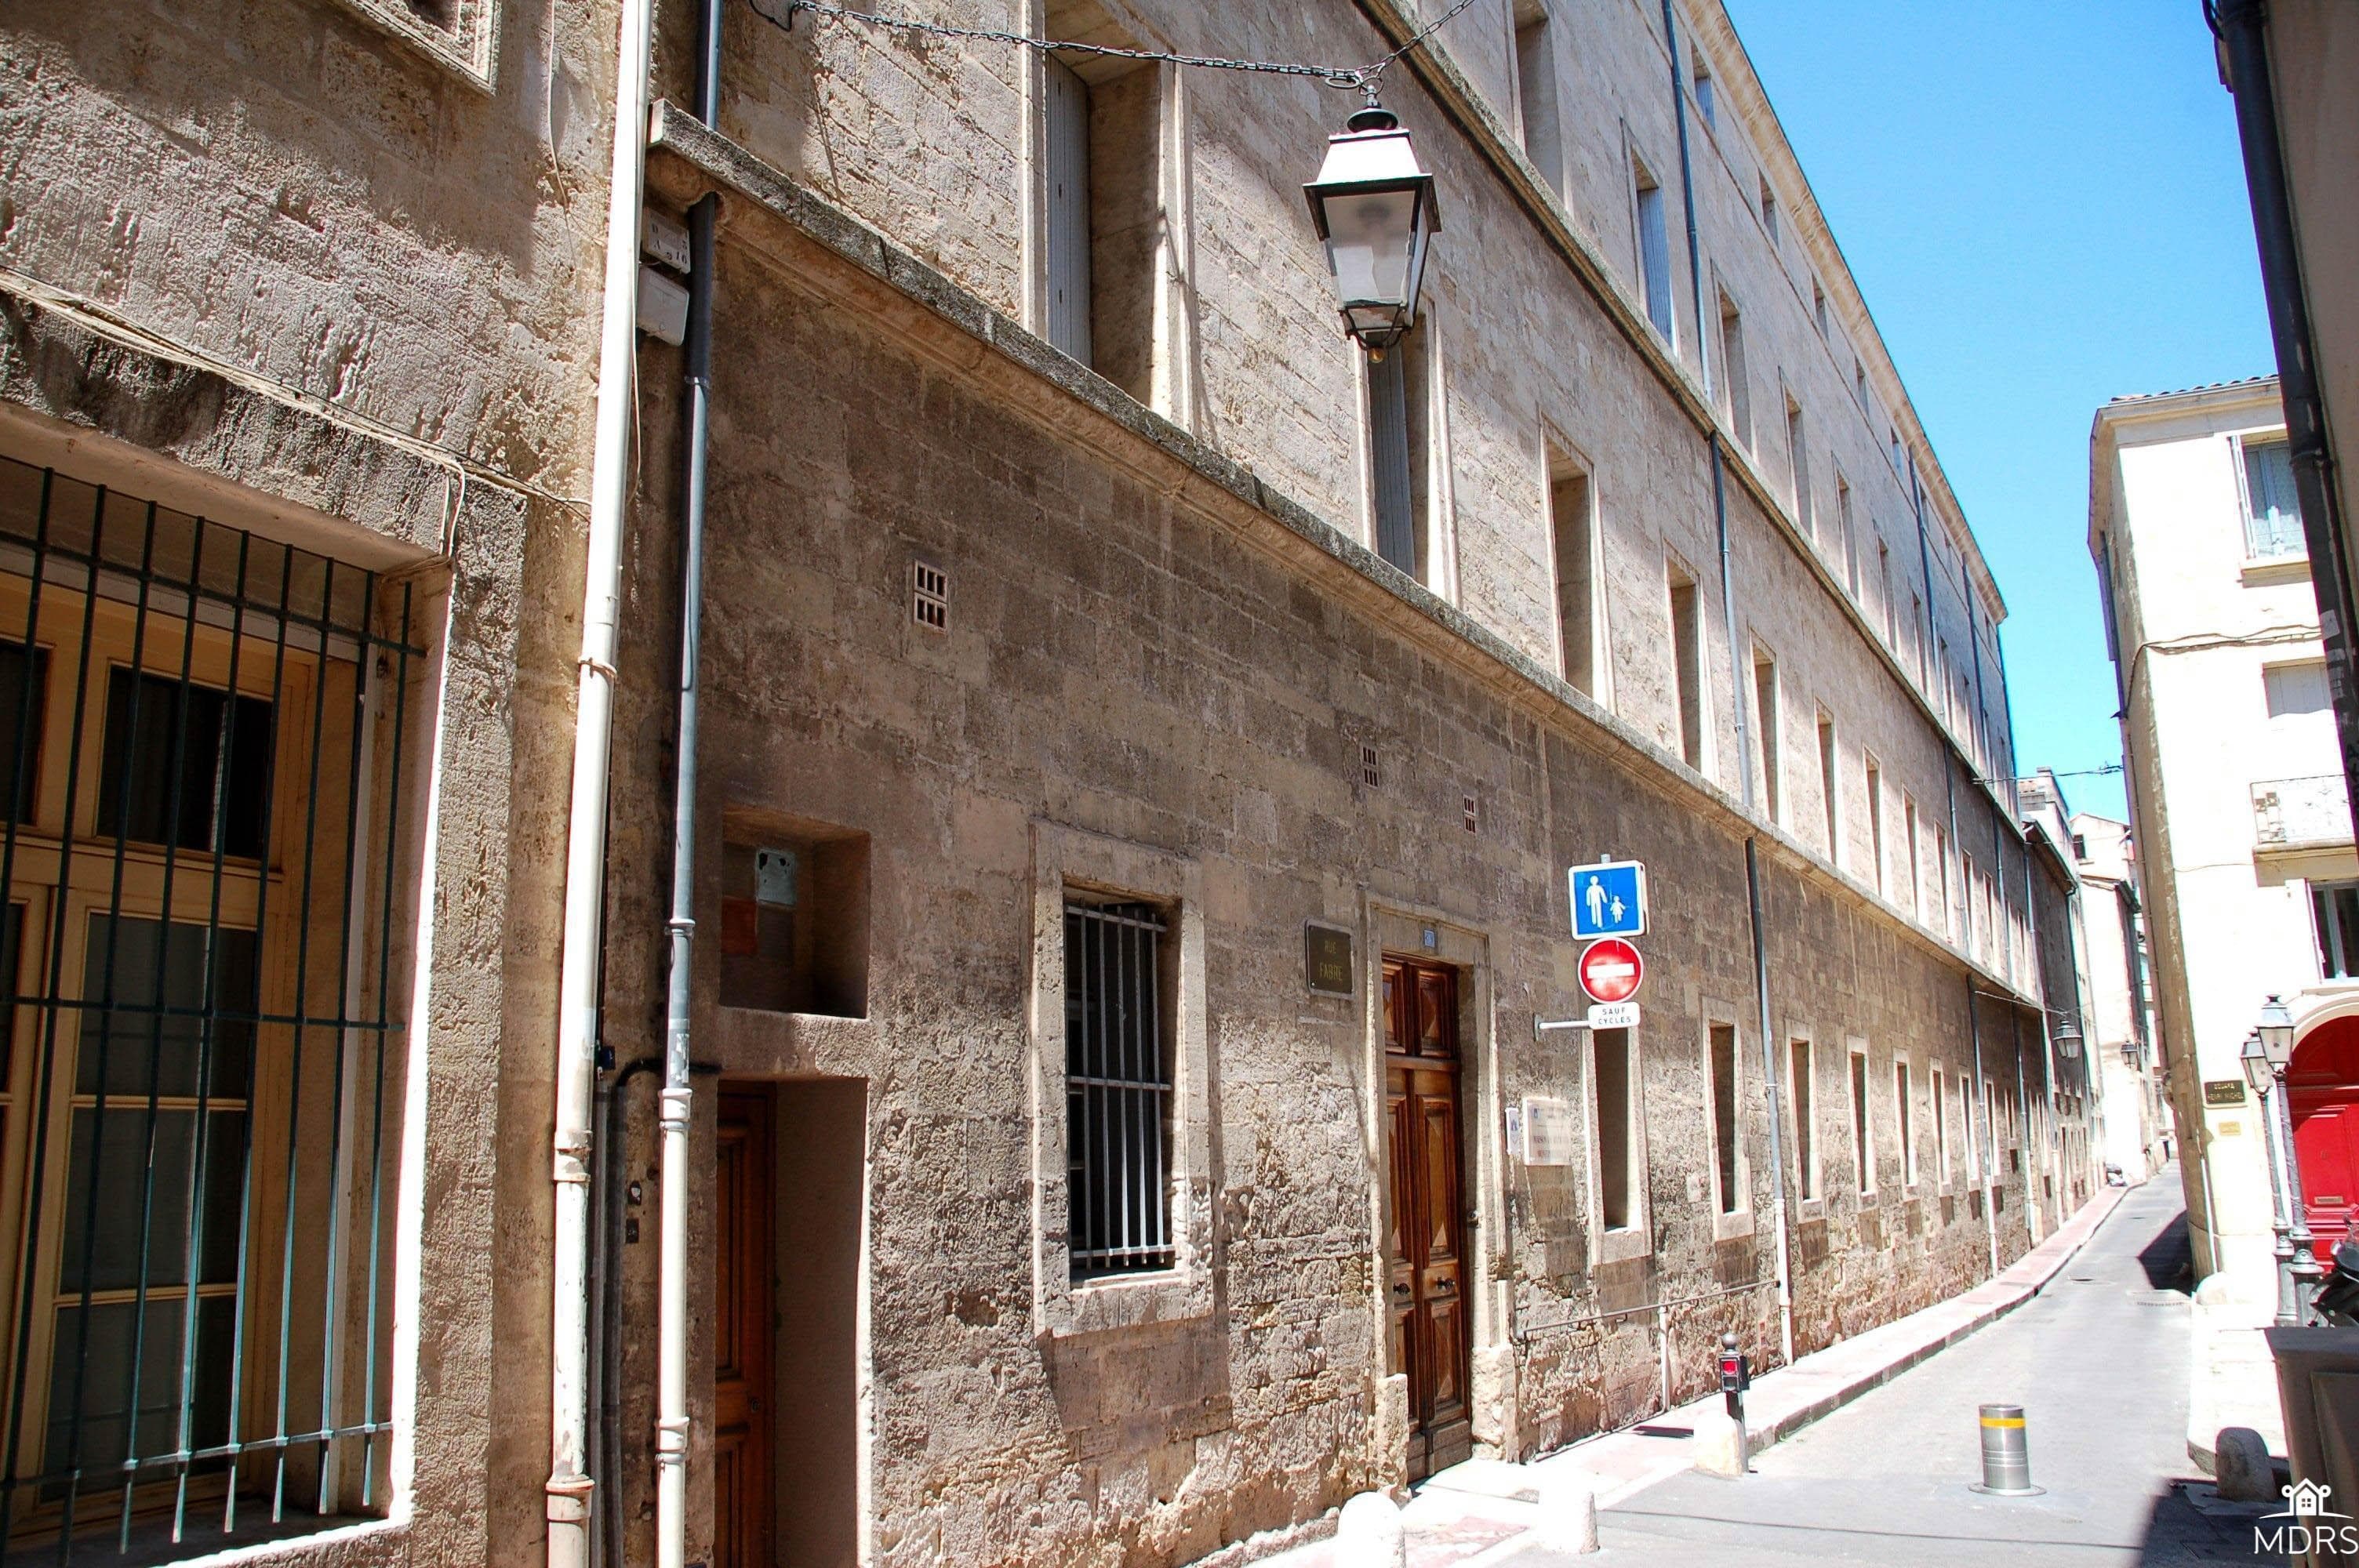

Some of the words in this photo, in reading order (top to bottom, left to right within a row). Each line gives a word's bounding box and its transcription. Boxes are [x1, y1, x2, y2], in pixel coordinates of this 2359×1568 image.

[1324, 940, 1337, 954] RUE
[1319, 962, 1343, 981] FABRE
[1602, 1006, 1626, 1016] SAUF
[1598, 1015, 1631, 1025] CYCLES
